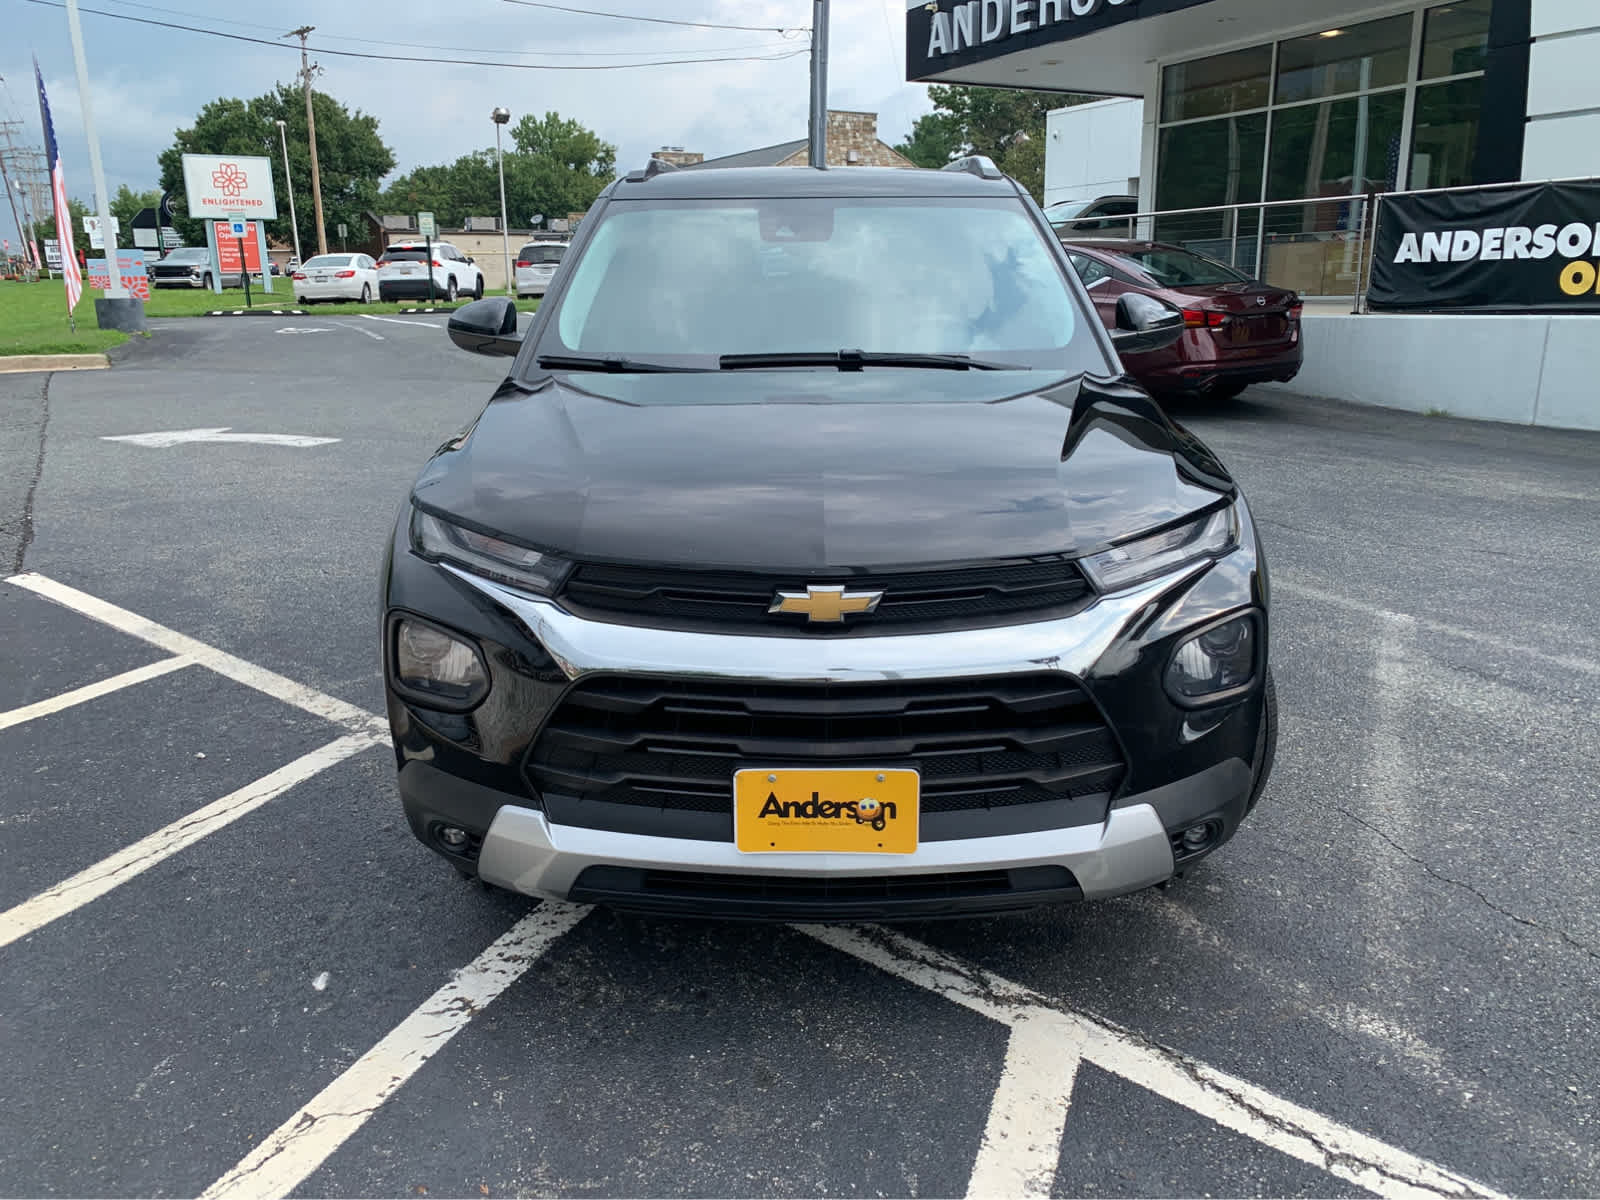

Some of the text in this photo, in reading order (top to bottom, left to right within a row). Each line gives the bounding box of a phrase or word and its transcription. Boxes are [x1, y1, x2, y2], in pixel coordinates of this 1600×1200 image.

[202, 197, 264, 207] ENLIGHTENED
[1393, 222, 1600, 264] ANDERSO
[1559, 260, 1600, 296] O
[758, 791, 897, 820] Anderson
